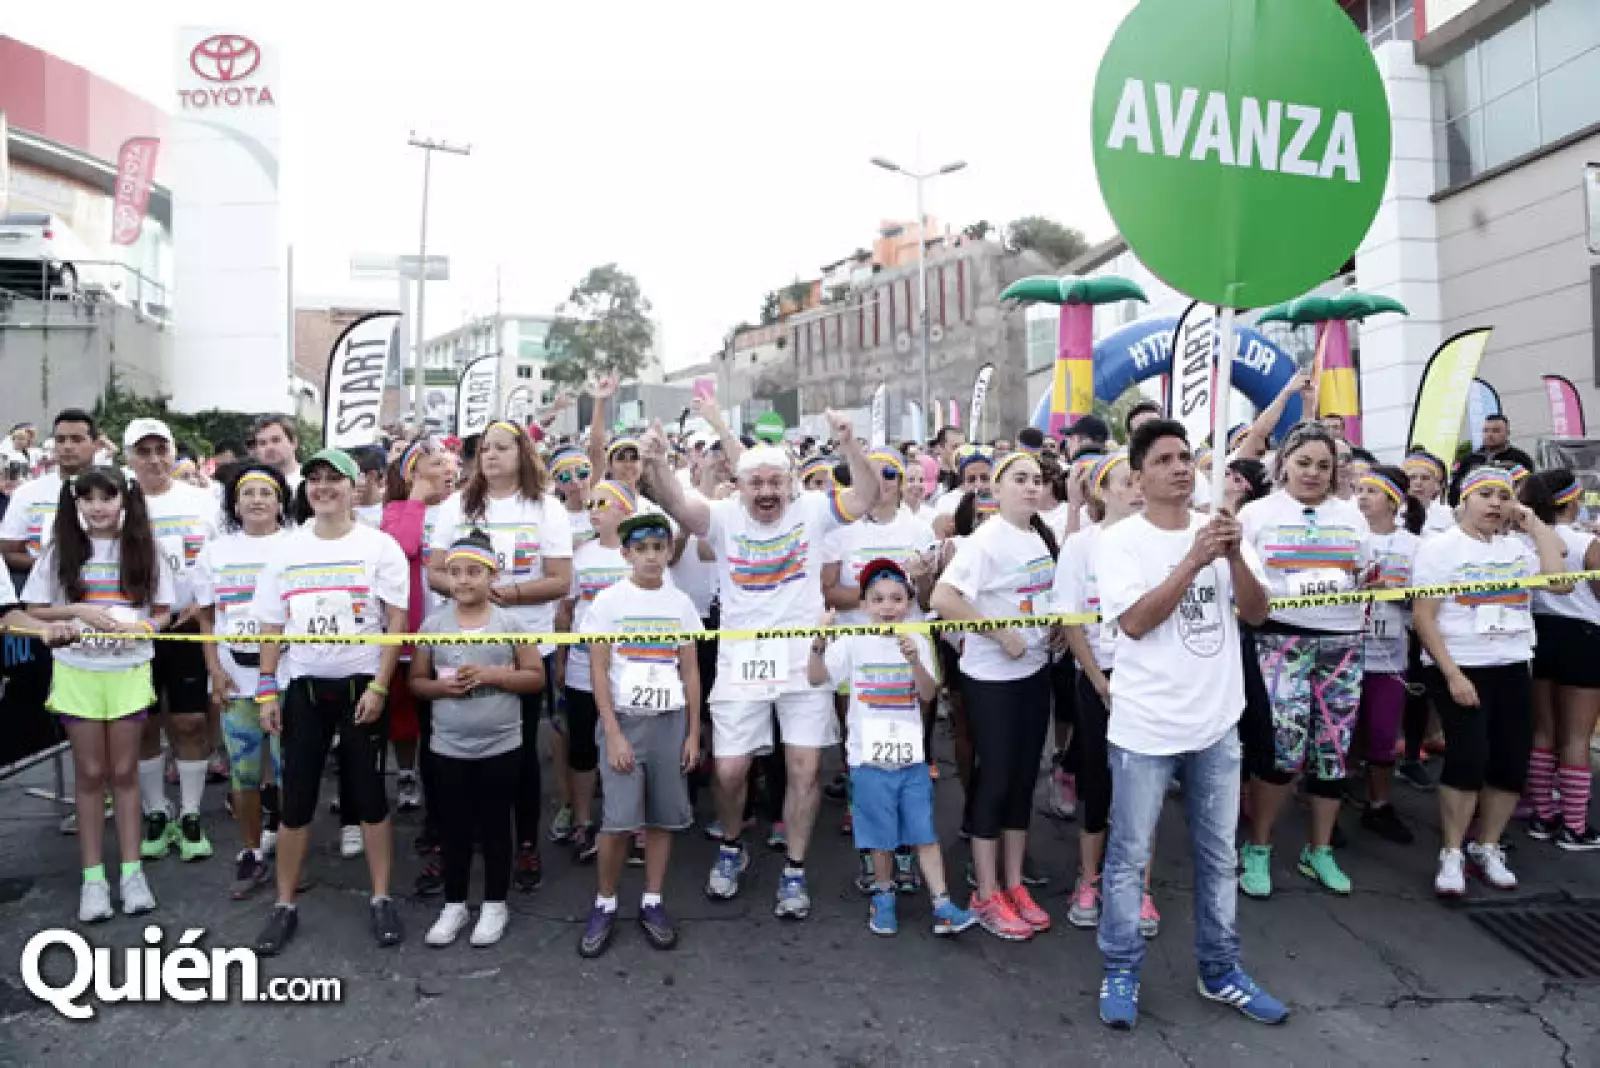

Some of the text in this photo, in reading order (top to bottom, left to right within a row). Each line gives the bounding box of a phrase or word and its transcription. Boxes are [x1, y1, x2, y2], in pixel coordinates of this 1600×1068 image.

[177, 86, 275, 109] TOYOTA
[1105, 77, 1361, 183] AVANZA
[1179, 317, 1213, 417] START
[335, 338, 387, 436] START
[465, 371, 494, 429] START
[307, 614, 339, 636] 424
[741, 659, 776, 681] 1721
[630, 685, 671, 709] 2211
[871, 741, 914, 764] 2213
